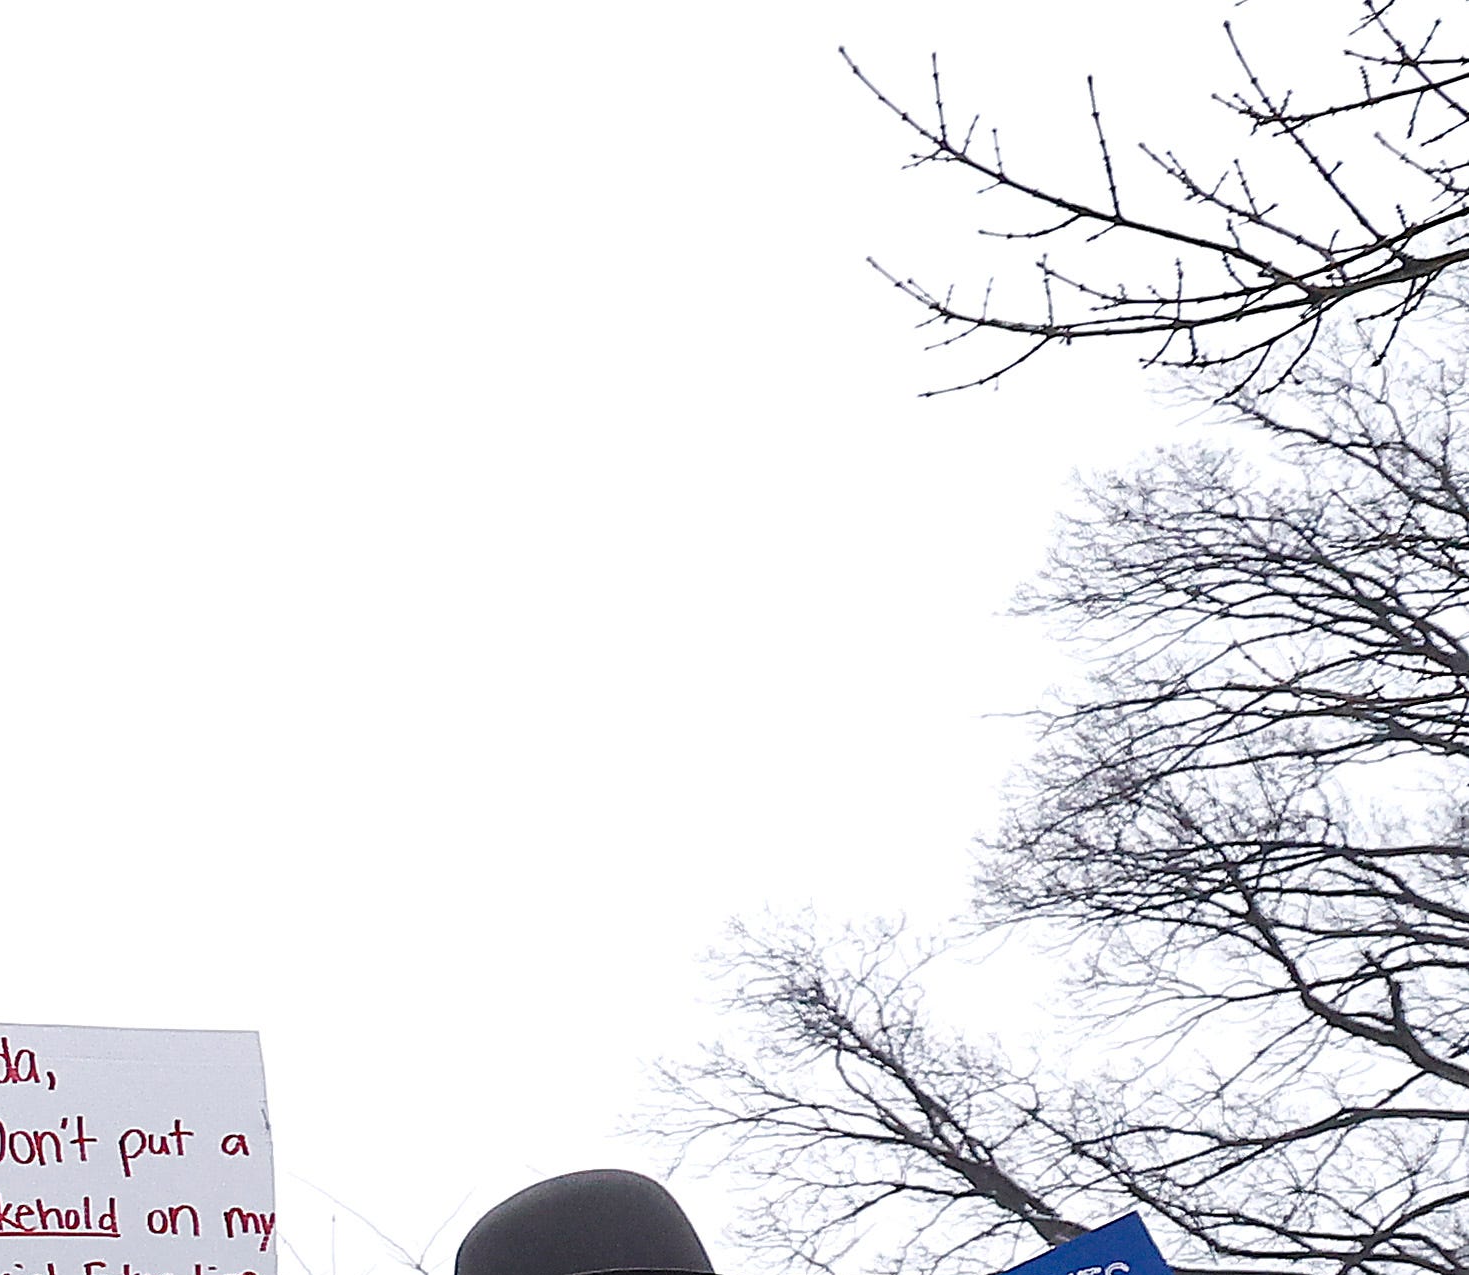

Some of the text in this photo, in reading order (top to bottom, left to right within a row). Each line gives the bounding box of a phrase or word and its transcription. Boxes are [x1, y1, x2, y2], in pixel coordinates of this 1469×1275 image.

[119, 1118, 195, 1177] put
[220, 1134, 250, 1157] a
[147, 1204, 200, 1237] on
[223, 1209, 275, 1252] my
